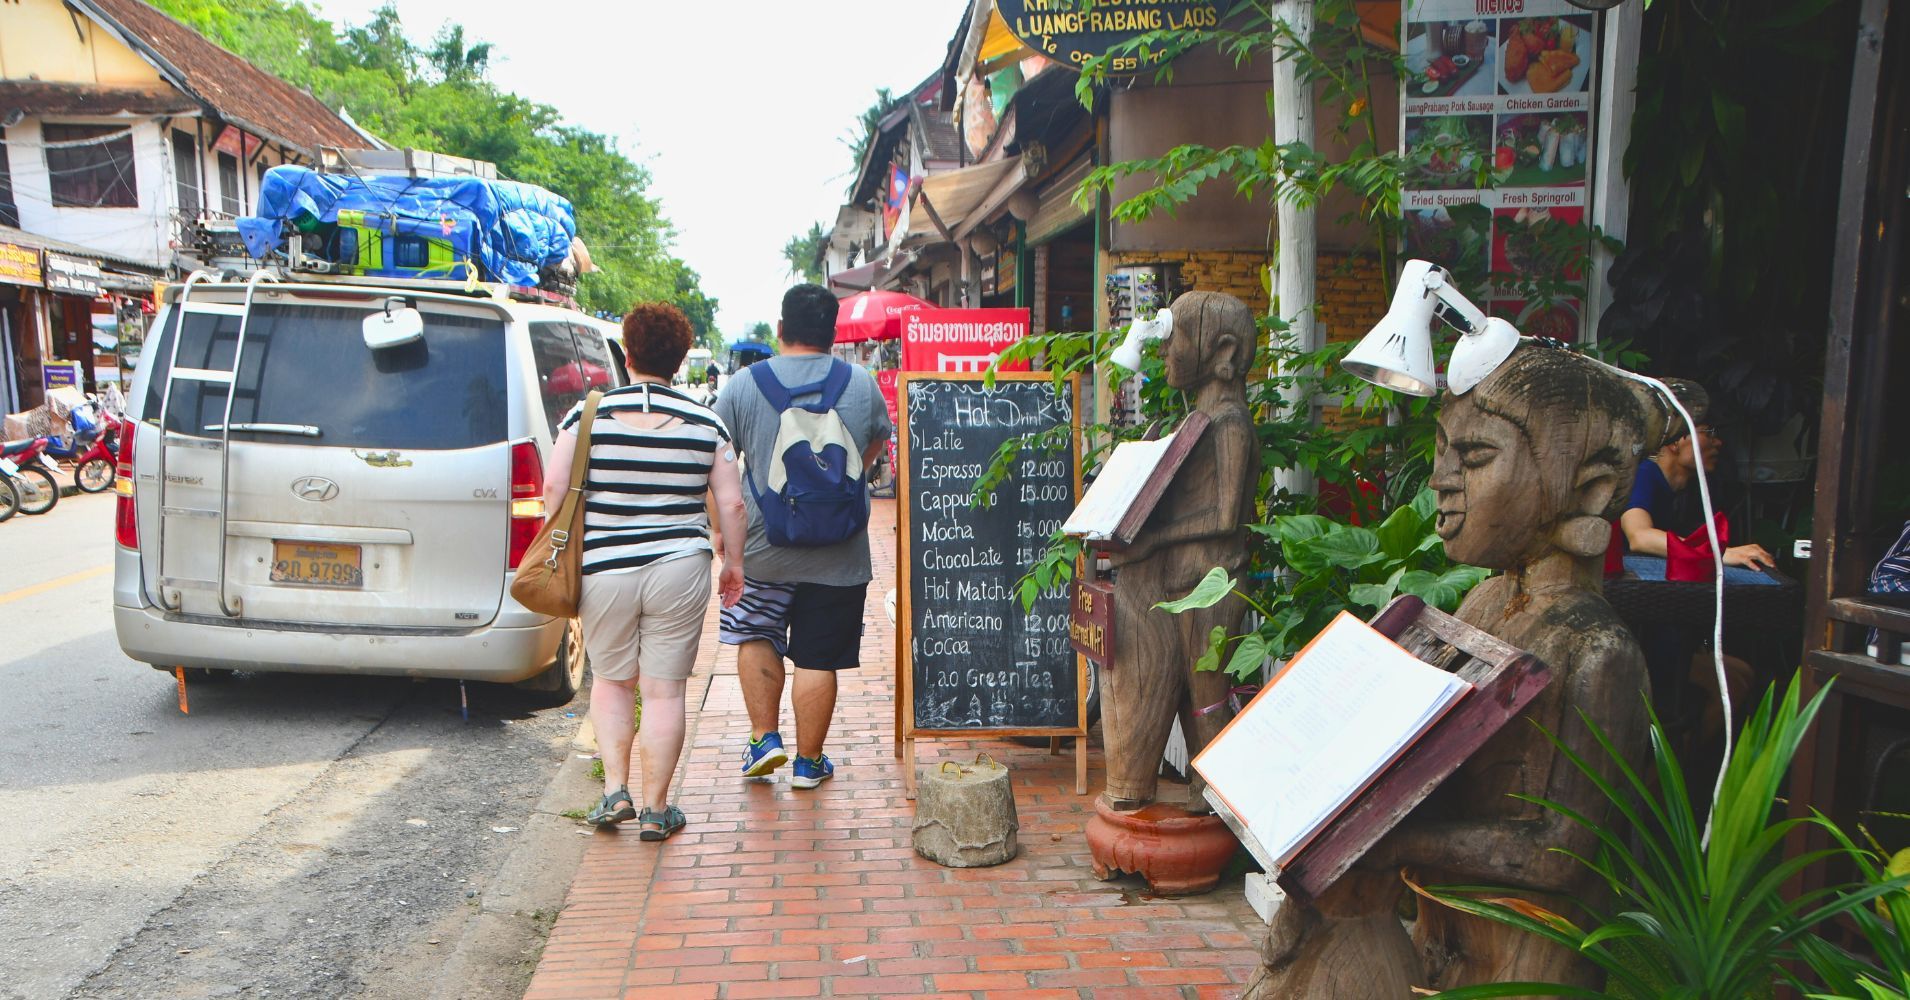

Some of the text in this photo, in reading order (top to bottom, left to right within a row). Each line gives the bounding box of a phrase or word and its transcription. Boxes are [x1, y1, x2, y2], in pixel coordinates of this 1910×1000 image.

[1016, 6, 1217, 38] LUANGPRABANG LAOS
[1113, 57, 1137, 70] 55
[1451, 101, 1466, 112] Pork
[1467, 101, 1494, 112] Sausage
[1506, 97, 1580, 109] Chicken Garden
[1411, 195, 1434, 205] Fried
[1502, 191, 1576, 205] Fresh Springroll
[955, 396, 991, 428] Hot
[922, 429, 964, 451] Latte
[920, 457, 1065, 487] Espresso 12.000
[472, 488, 497, 498] CVX
[1020, 484, 1068, 502] 15.000
[922, 518, 974, 542] Mocha
[310, 561, 353, 579] 9799
[924, 577, 950, 600] Hot
[1078, 584, 1093, 614] Free
[923, 608, 1003, 631] Americano
[925, 665, 959, 689] Lao
